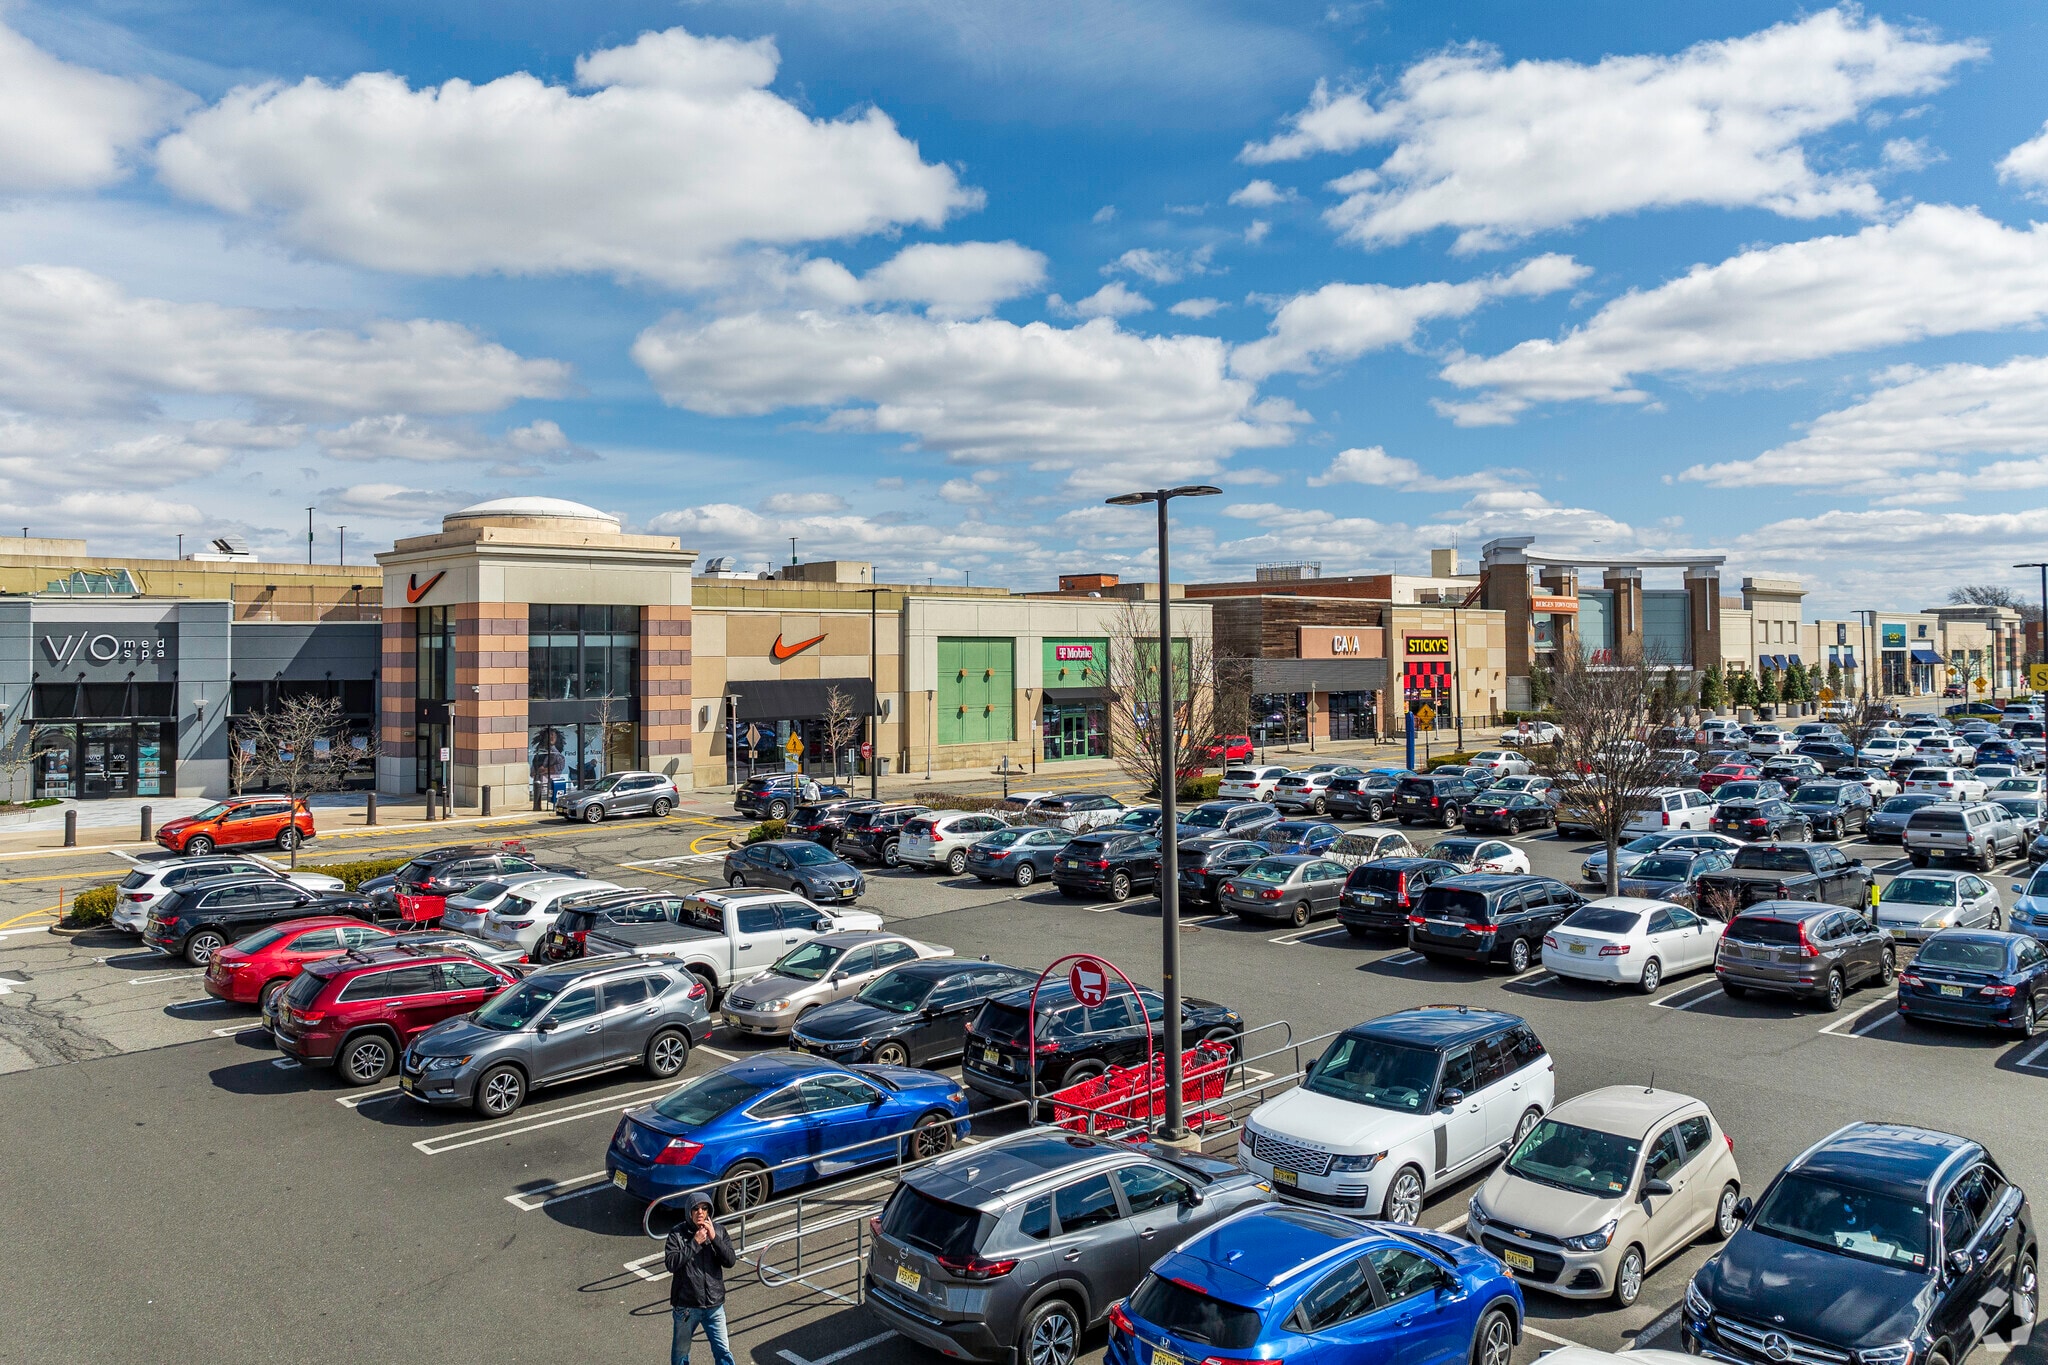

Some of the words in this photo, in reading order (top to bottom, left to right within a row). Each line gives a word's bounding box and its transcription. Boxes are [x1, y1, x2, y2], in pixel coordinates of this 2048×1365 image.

[123, 638, 165, 648] med
[1333, 635, 1360, 652] CAVA
[1409, 638, 1448, 652] STICKY'S
[123, 649, 165, 660] spa
[1067, 647, 1092, 659] Mobile
